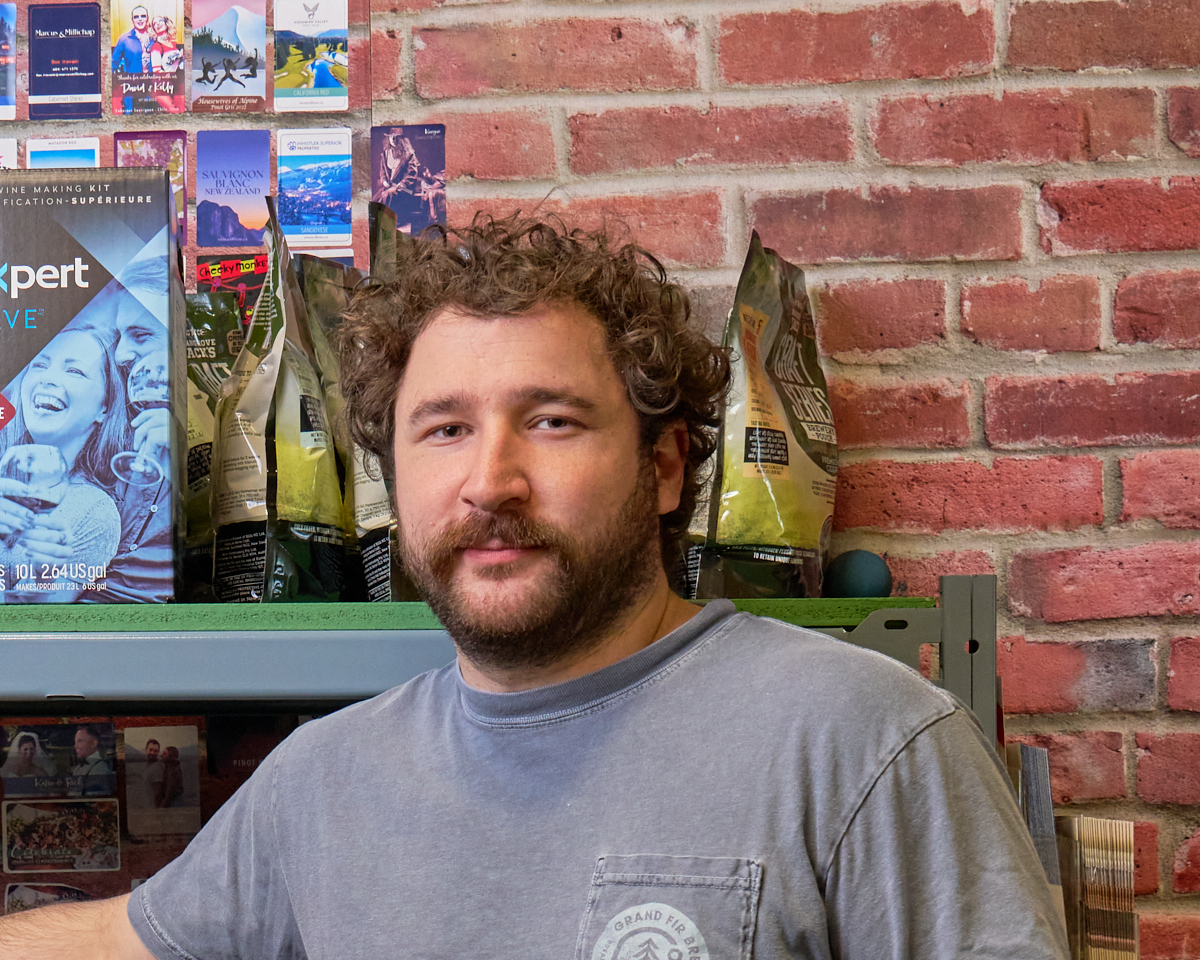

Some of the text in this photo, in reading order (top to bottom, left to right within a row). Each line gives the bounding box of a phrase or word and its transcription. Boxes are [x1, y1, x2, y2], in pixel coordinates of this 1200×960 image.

[35, 29, 58, 37] Marcus
[65, 29, 95, 37] Millichap
[121, 83, 145, 94] David
[154, 82, 174, 94] Kelly
[231, 97, 239, 105] of
[240, 97, 258, 105] Alpine
[202, 170, 264, 179] SAUVIGNON
[216, 179, 250, 188] BLANC
[225, 187, 261, 195] ZEALAND
[614, 910, 663, 932] GRAND
[665, 914, 686, 935] FIR
